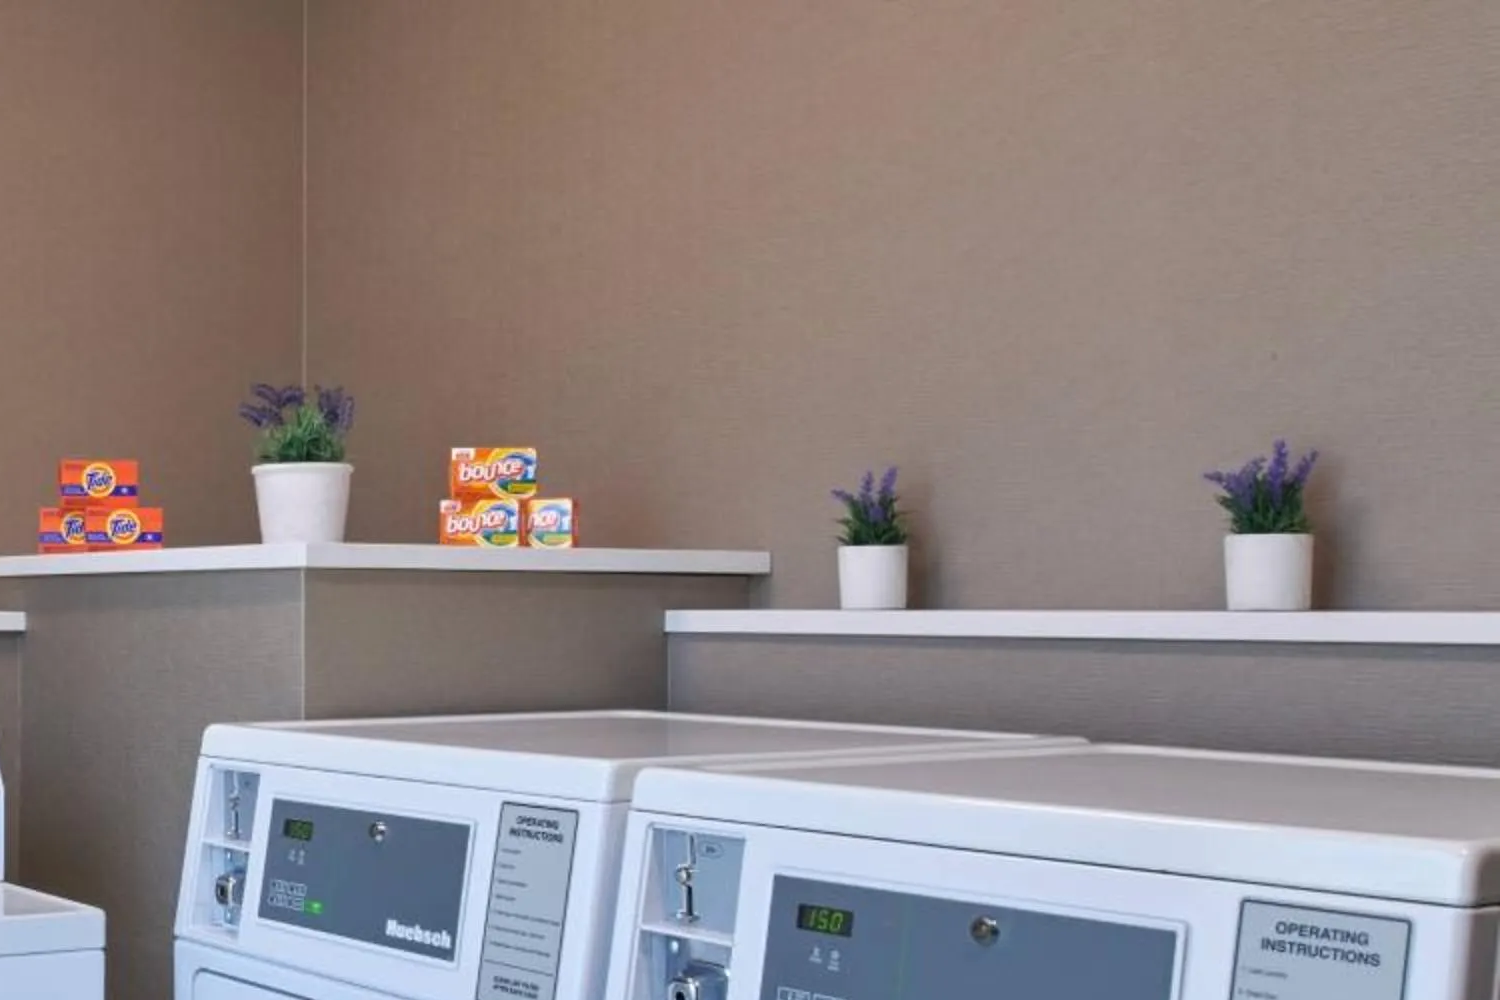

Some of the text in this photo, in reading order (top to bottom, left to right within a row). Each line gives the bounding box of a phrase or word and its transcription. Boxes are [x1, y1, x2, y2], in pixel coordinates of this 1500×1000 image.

[86, 470, 113, 490] Tide
[110, 517, 138, 537] Tide
[808, 908, 844, 932] 150
[385, 918, 453, 950] Huebsch
[1275, 920, 1370, 947] OPERATING
[1261, 936, 1381, 968] INSTRUCTIONS
